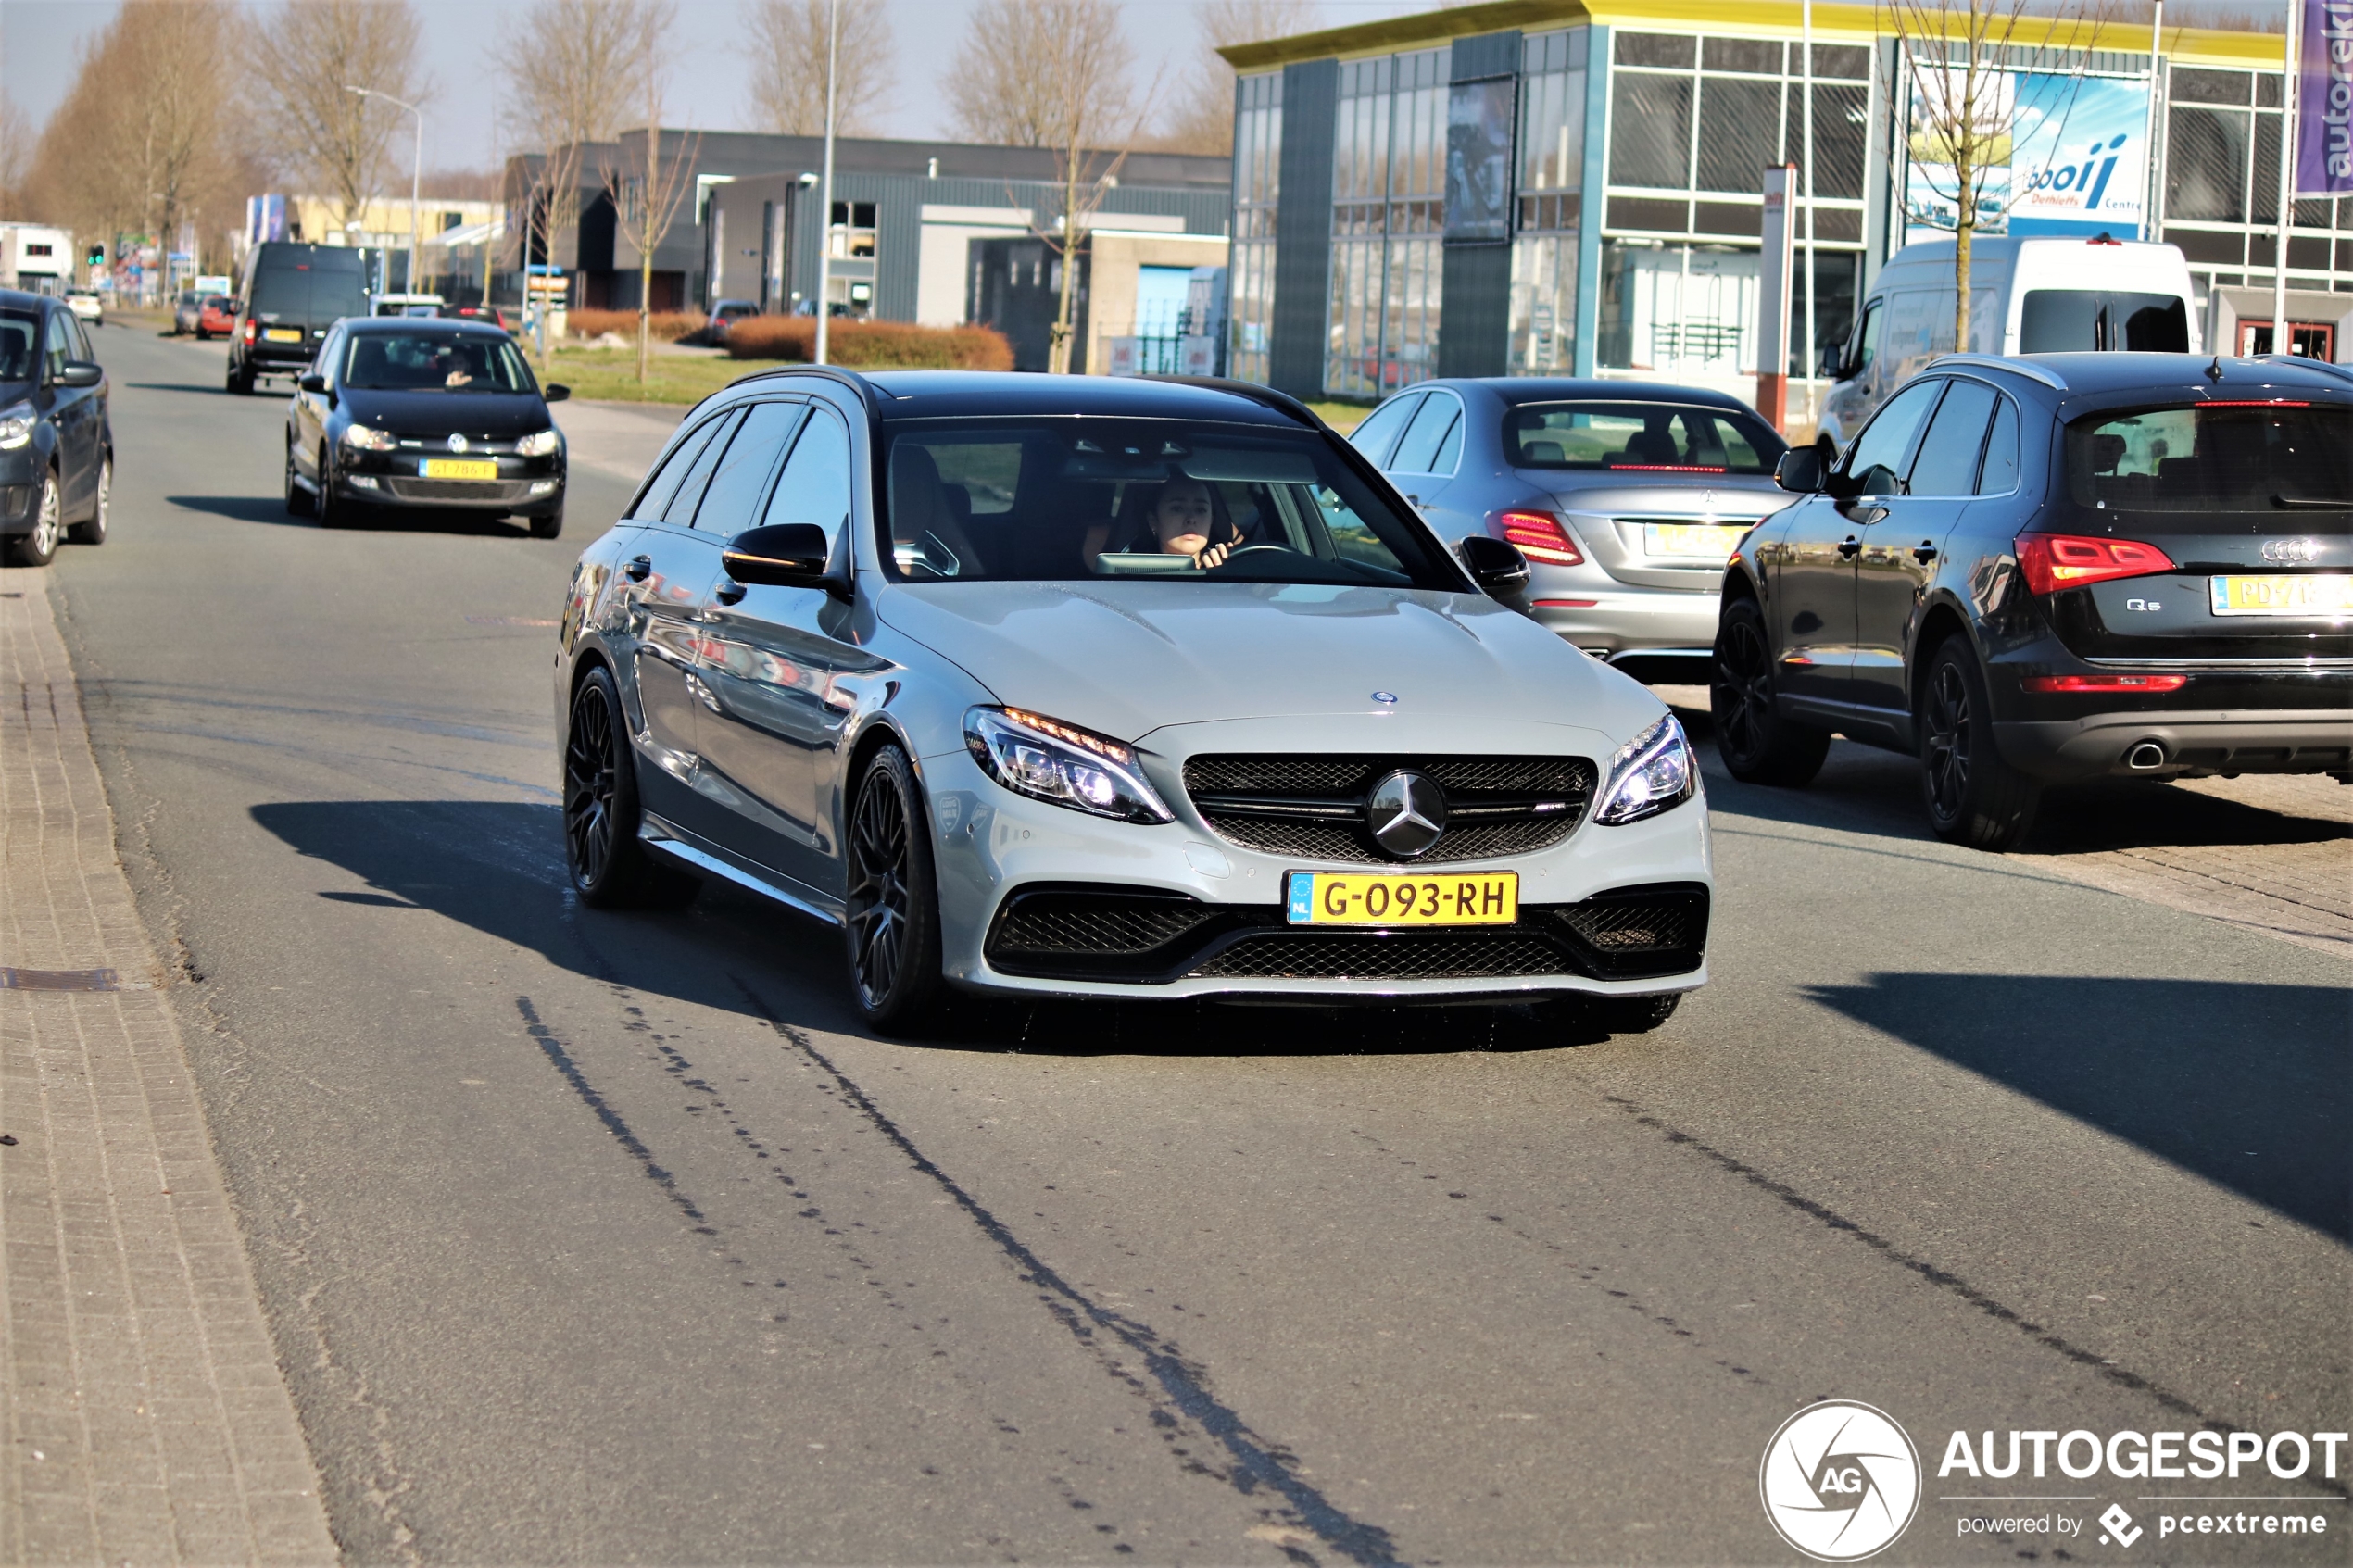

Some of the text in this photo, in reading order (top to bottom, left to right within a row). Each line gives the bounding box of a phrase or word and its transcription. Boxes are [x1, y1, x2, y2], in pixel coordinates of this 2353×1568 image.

[2322, 0, 2353, 178] autorekl
[2126, 599, 2161, 611] Q5
[1292, 881, 1504, 917] NL G-093-RH
